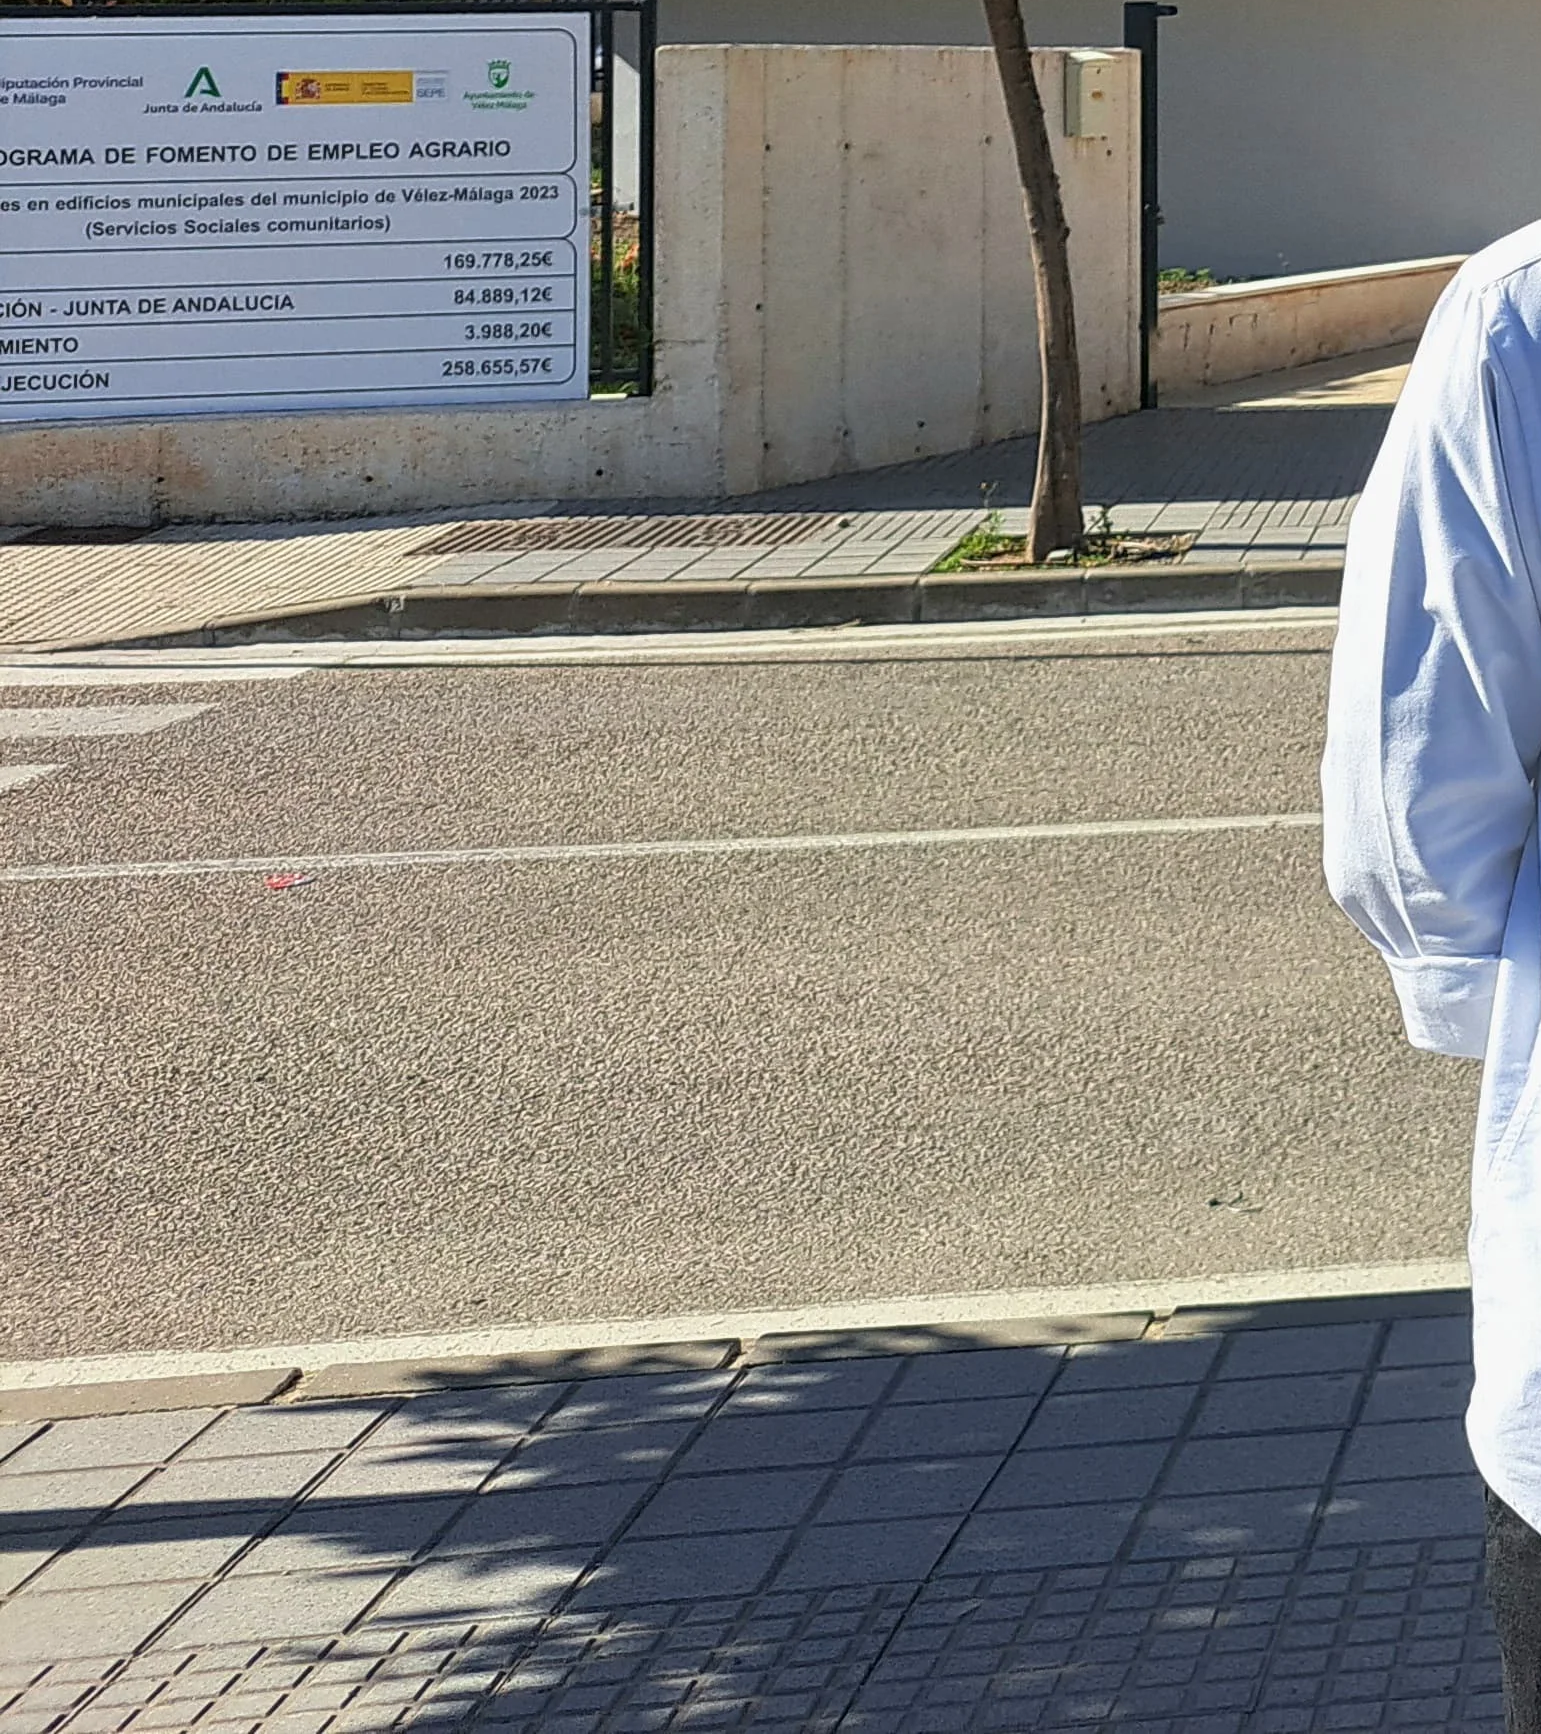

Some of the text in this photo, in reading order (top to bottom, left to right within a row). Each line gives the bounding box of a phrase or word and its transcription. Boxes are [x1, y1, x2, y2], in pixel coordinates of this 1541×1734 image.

[73, 76, 144, 89] Provincial
[12, 92, 67, 107] Málaga
[143, 100, 263, 114] Junta de Andalucía
[104, 147, 136, 165] DE
[146, 144, 257, 164] FOMENTO
[267, 144, 299, 162] DE
[307, 142, 400, 161] EMPLEO
[408, 139, 511, 159] AGRARIO
[26, 200, 50, 212] en
[55, 194, 132, 211] edificios
[137, 192, 245, 211] municipales
[250, 191, 277, 207] del
[282, 189, 369, 208] municipio
[374, 189, 396, 204] de
[401, 186, 514, 204] Vélez-Málaga
[519, 185, 560, 201] 2023
[85, 214, 391, 240] (Servicios Sociales comunitarios)
[443, 250, 553, 271] 169.778,25€
[453, 286, 553, 306] 84.889,12€
[62, 299, 132, 317] JUNTA
[137, 297, 167, 315] DE
[464, 321, 553, 342] 3.988,20€
[441, 357, 553, 378] 258.655,57€
